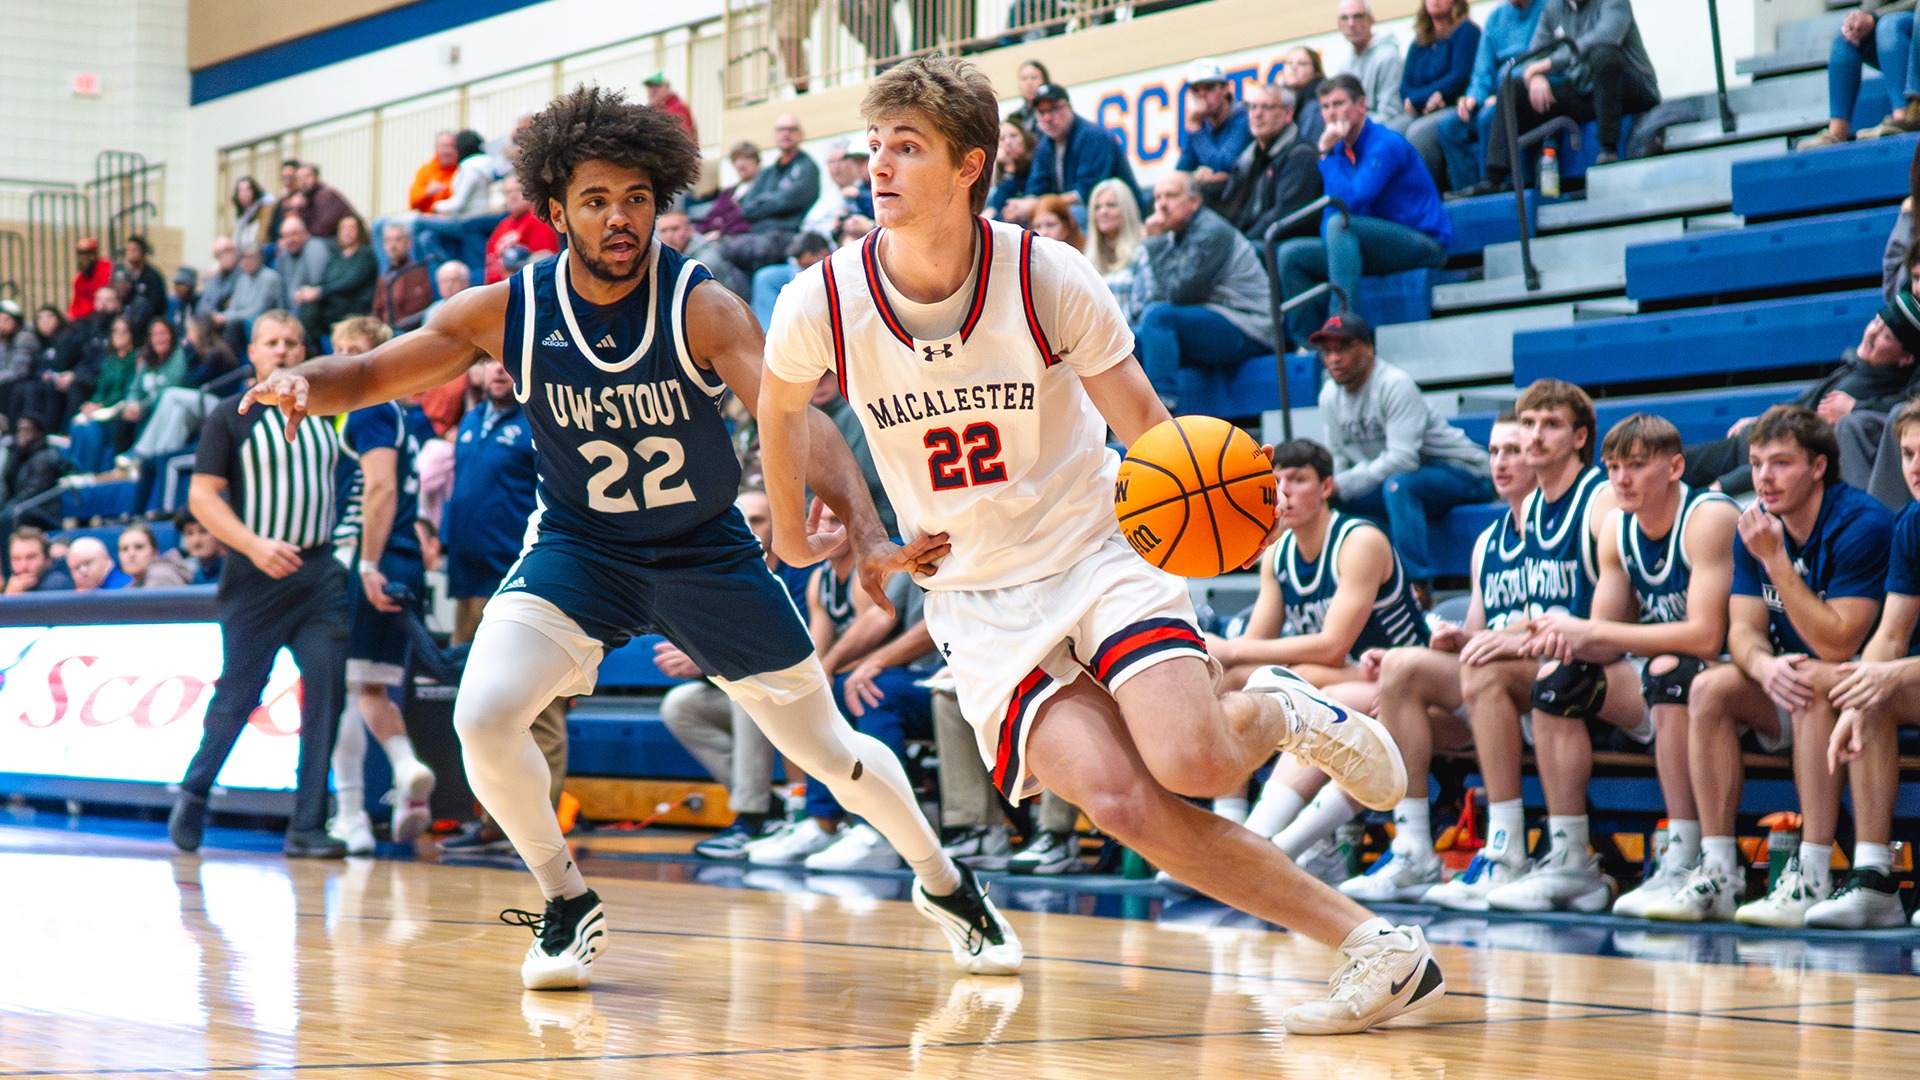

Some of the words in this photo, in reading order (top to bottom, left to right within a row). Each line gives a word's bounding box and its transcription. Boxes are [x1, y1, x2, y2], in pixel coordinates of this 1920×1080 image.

[541, 339, 569, 348] adidas
[544, 378, 691, 433] UW-STOUT
[866, 382, 1036, 430] MACALESTER
[576, 435, 697, 514] 22
[922, 420, 1009, 492] 22
